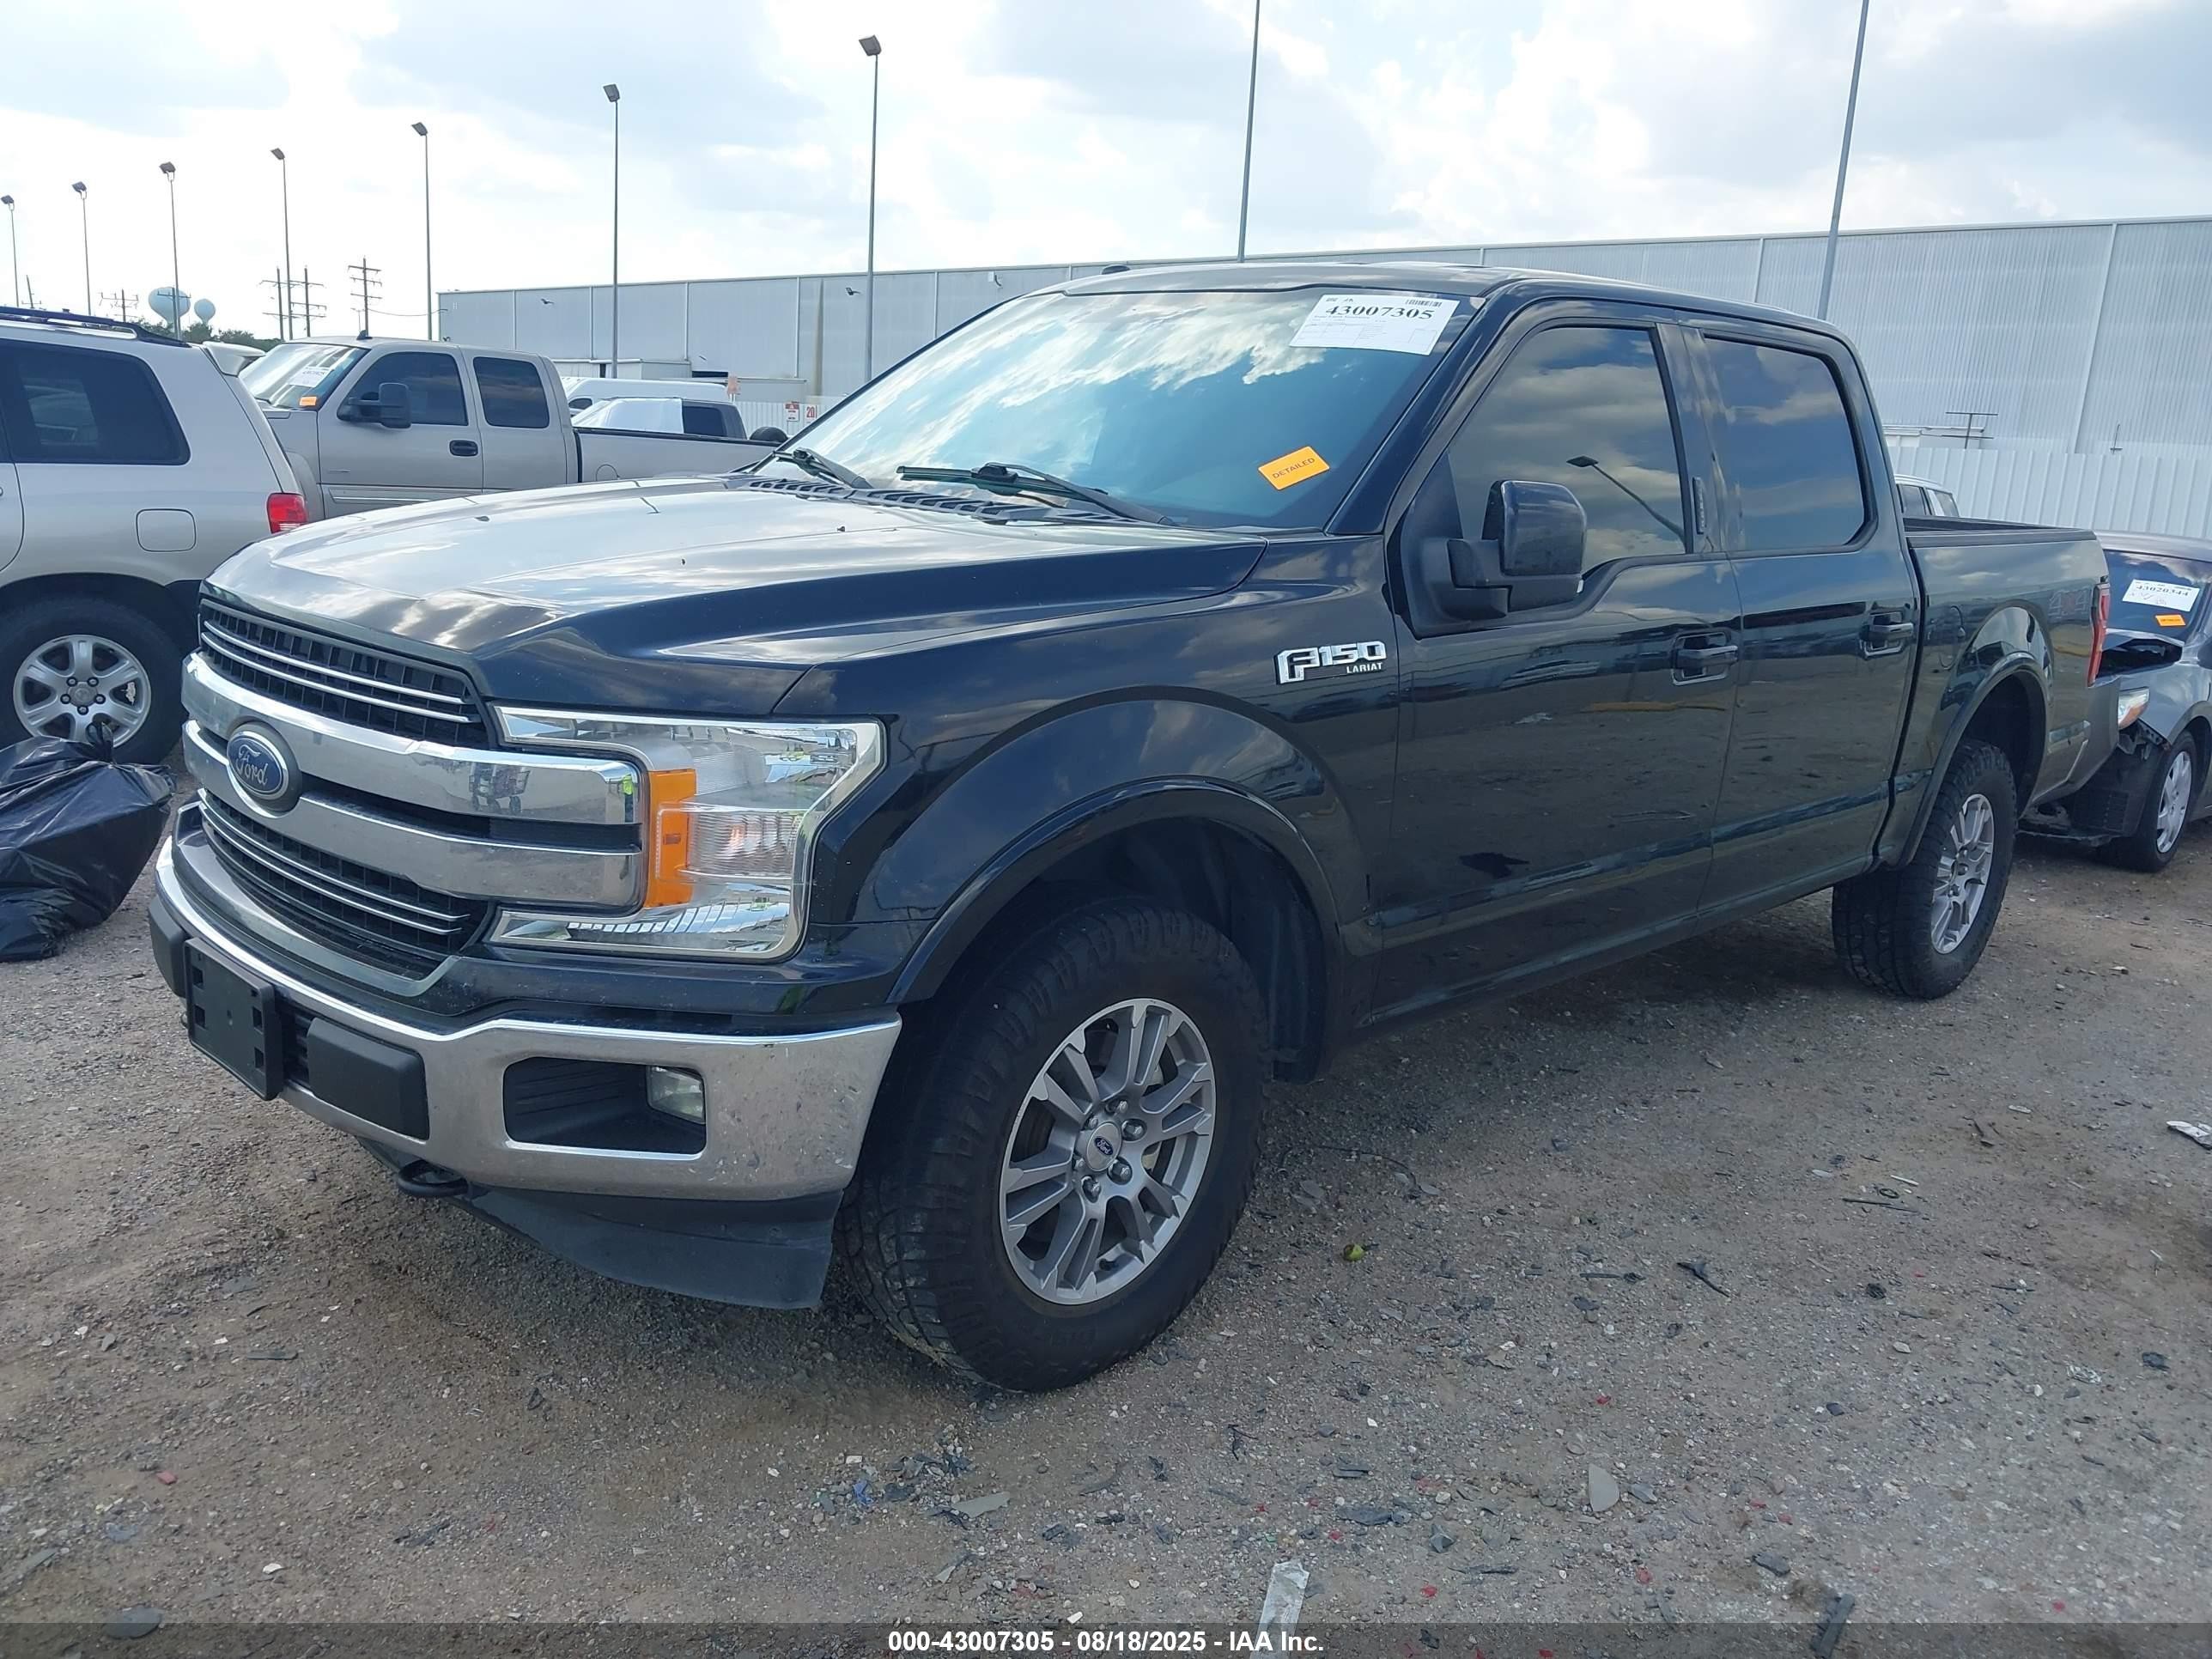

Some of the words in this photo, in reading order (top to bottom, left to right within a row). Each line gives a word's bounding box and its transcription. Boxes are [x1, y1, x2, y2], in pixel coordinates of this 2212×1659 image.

[1326, 306, 1436, 320] 43007305
[1272, 457, 1316, 479] DETAILED
[1346, 662, 1383, 674] LARIAT
[235, 744, 269, 786] Ford
[1097, 1139, 1112, 1154] Ford
